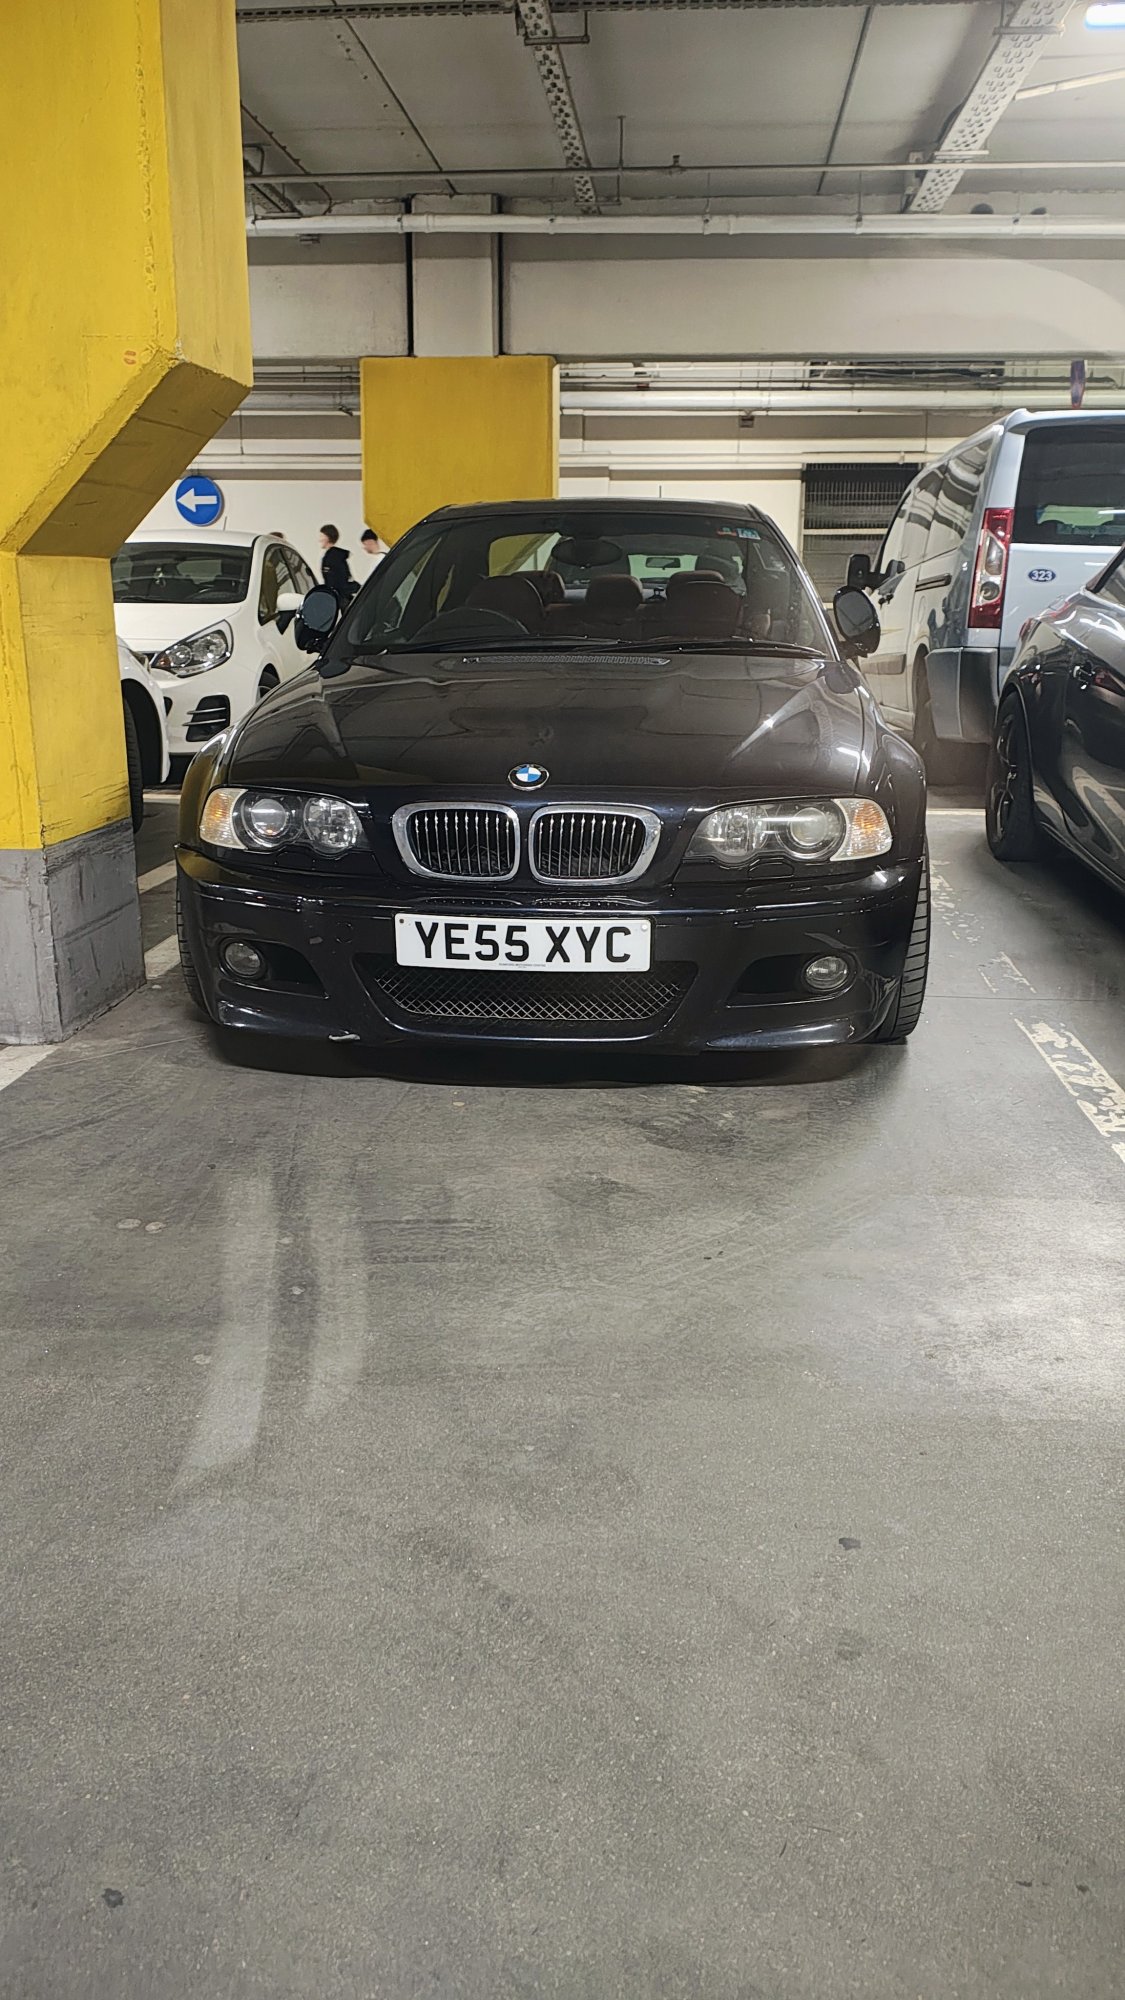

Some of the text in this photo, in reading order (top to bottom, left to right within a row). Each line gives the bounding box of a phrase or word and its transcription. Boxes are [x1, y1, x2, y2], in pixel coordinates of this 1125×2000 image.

[1031, 570, 1053, 581] 323
[415, 921, 631, 963] YE55 XYC
